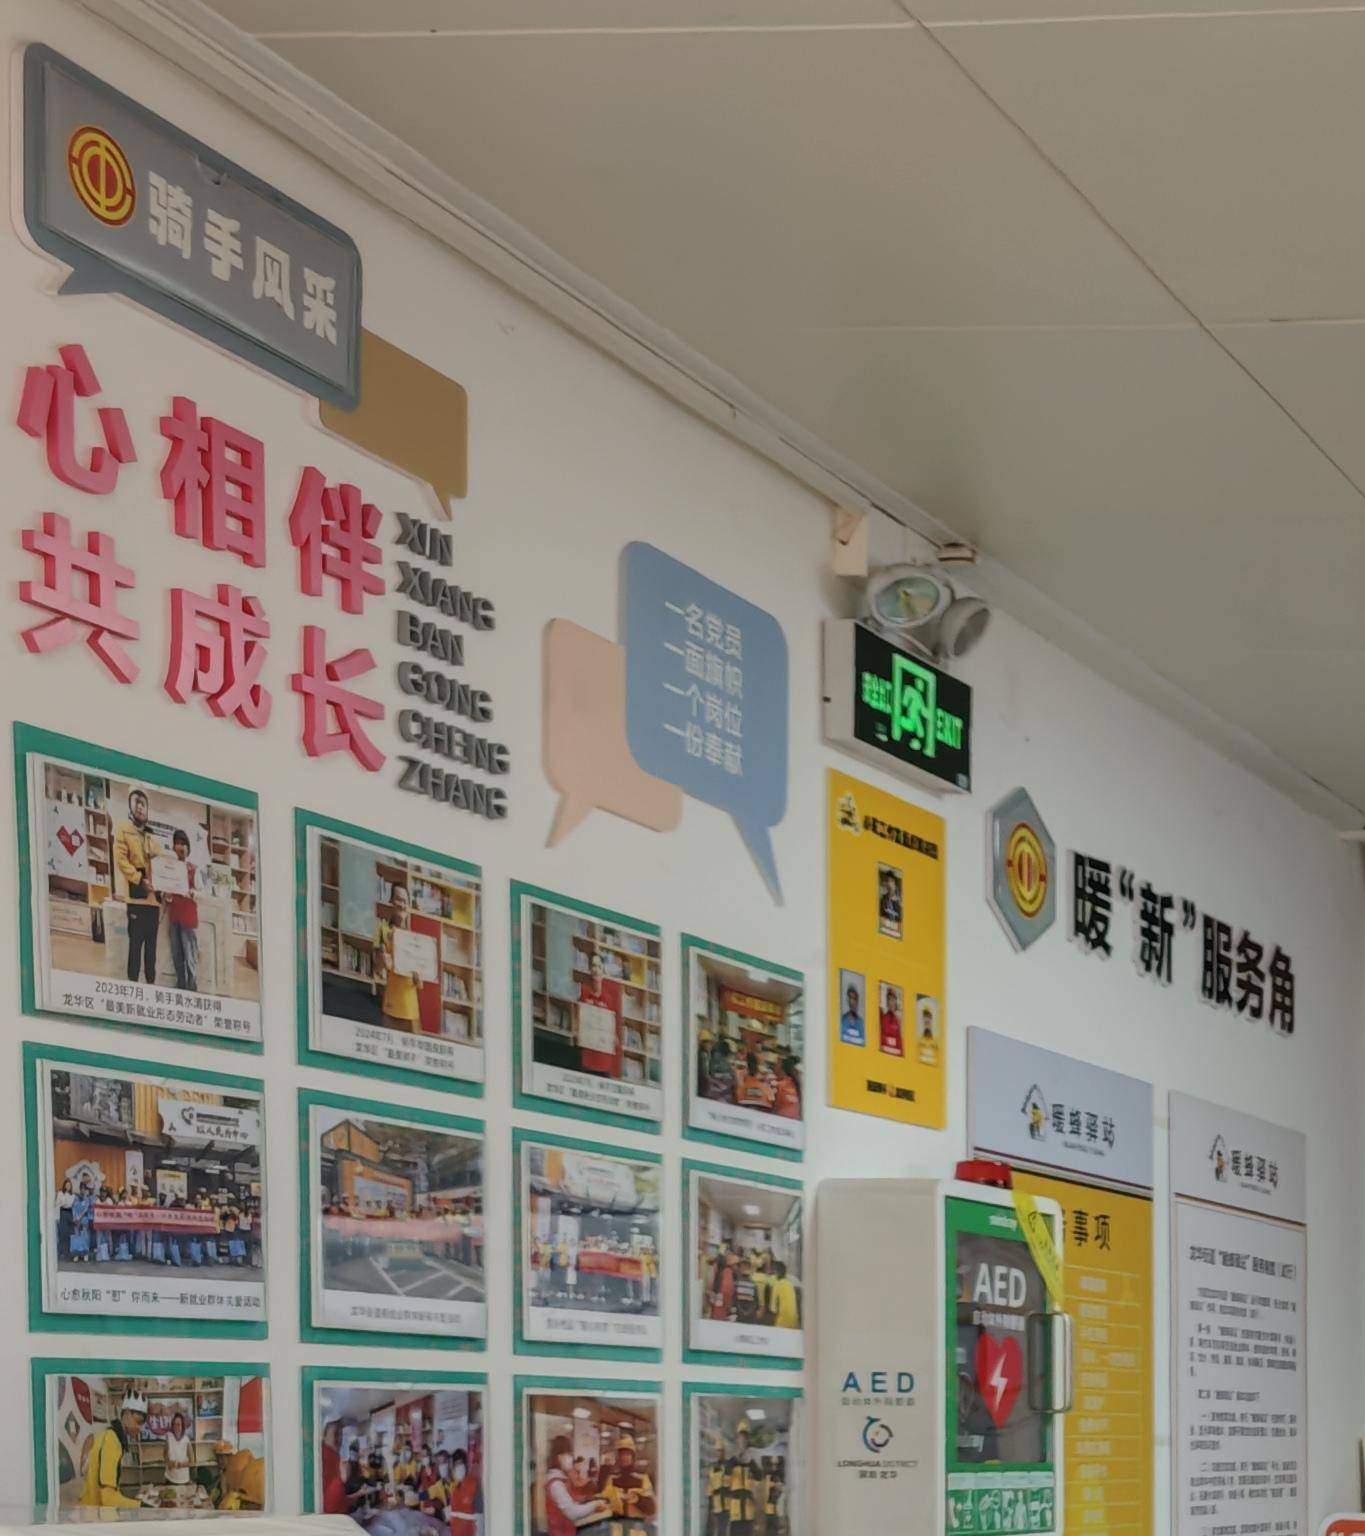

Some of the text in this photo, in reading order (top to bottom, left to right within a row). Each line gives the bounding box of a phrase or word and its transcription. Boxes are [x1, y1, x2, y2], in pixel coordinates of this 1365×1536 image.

[147, 170, 339, 345] 骑手风采
[16, 343, 386, 615] 心相伴
[395, 513, 454, 567] XIN
[396, 560, 497, 631] XIANG
[19, 511, 386, 773] 共成长
[397, 610, 465, 667] BAN
[664, 600, 744, 661] 一名党员
[397, 661, 494, 722] GONG
[664, 643, 745, 702] 一面旗帜
[664, 682, 745, 737] 一个岗位
[397, 711, 511, 776] CHENG
[664, 724, 745, 779] 一份奉献
[397, 755, 508, 821] ZHANG
[1072, 851, 1296, 1036] 暖“新”服务角
[1063, 1207, 1112, 1250] 事项
[973, 1262, 1027, 1309] AED
[842, 1371, 915, 1393] AED
